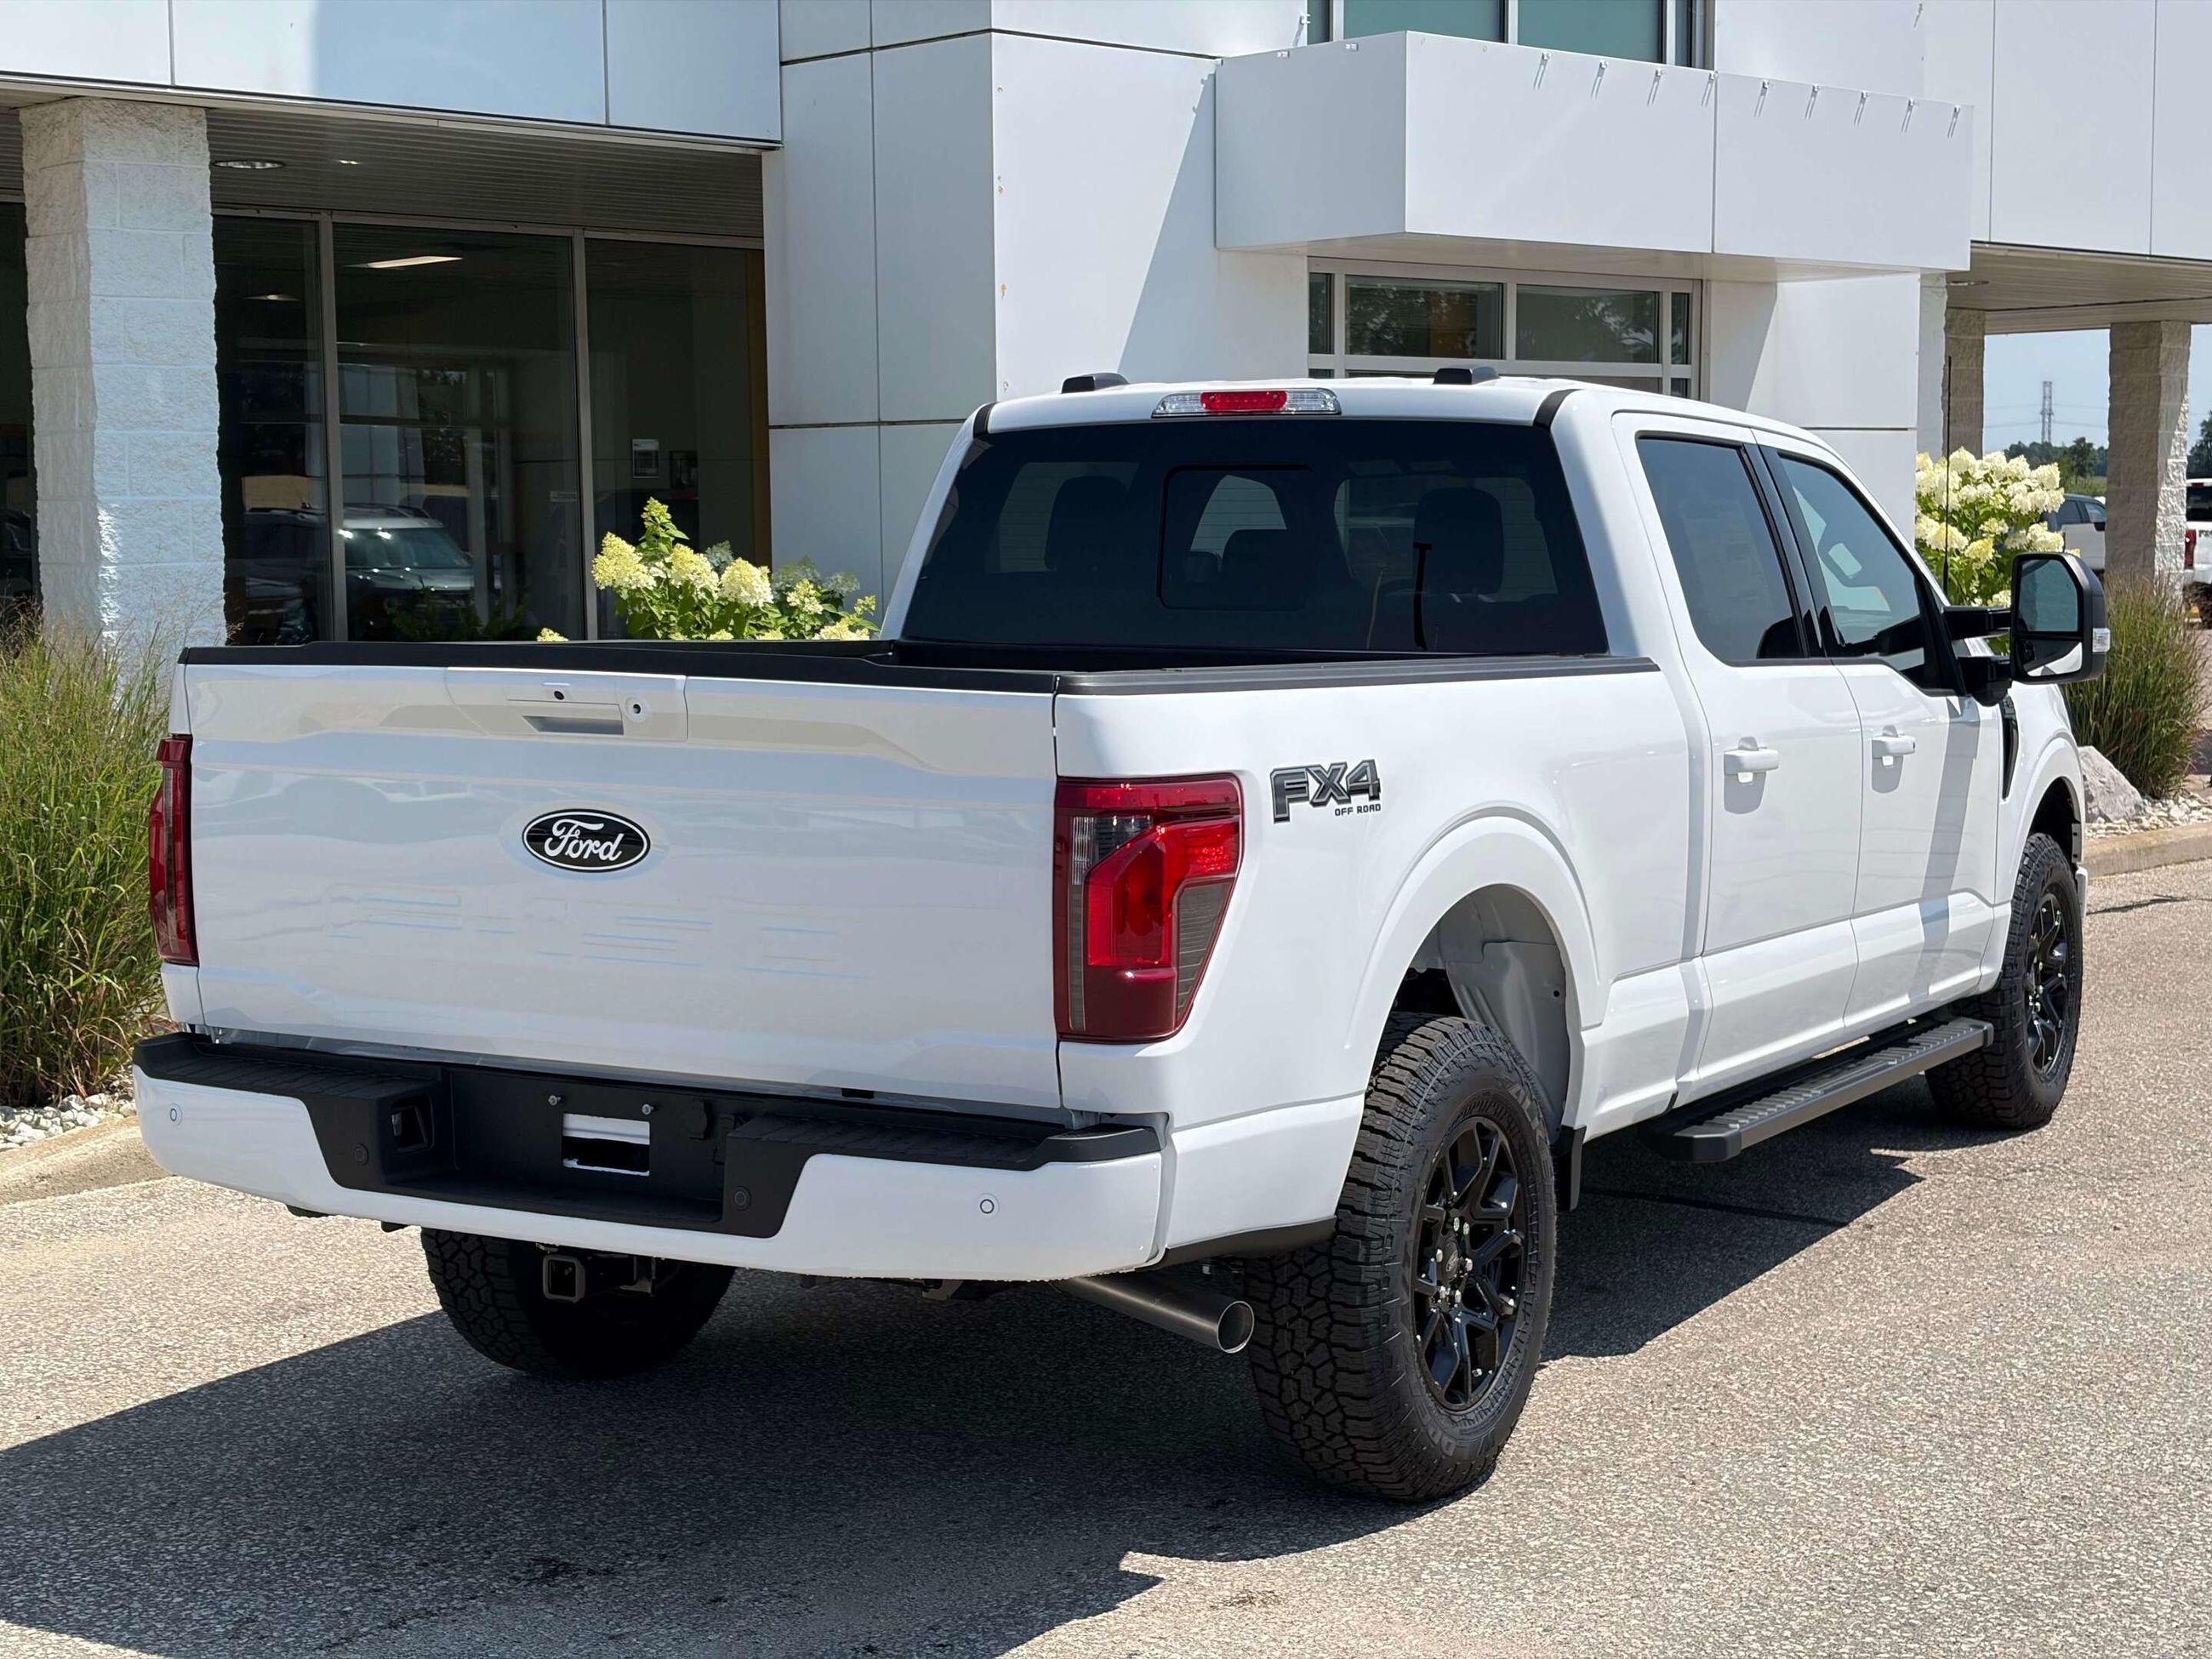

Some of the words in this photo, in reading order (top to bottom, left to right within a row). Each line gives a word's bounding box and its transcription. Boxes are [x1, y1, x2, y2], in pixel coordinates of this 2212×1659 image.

[1269, 759, 1381, 824] FX4
[1334, 807, 1354, 817] OFF
[1357, 803, 1382, 814] ROAD
[544, 818, 624, 862] Ford
